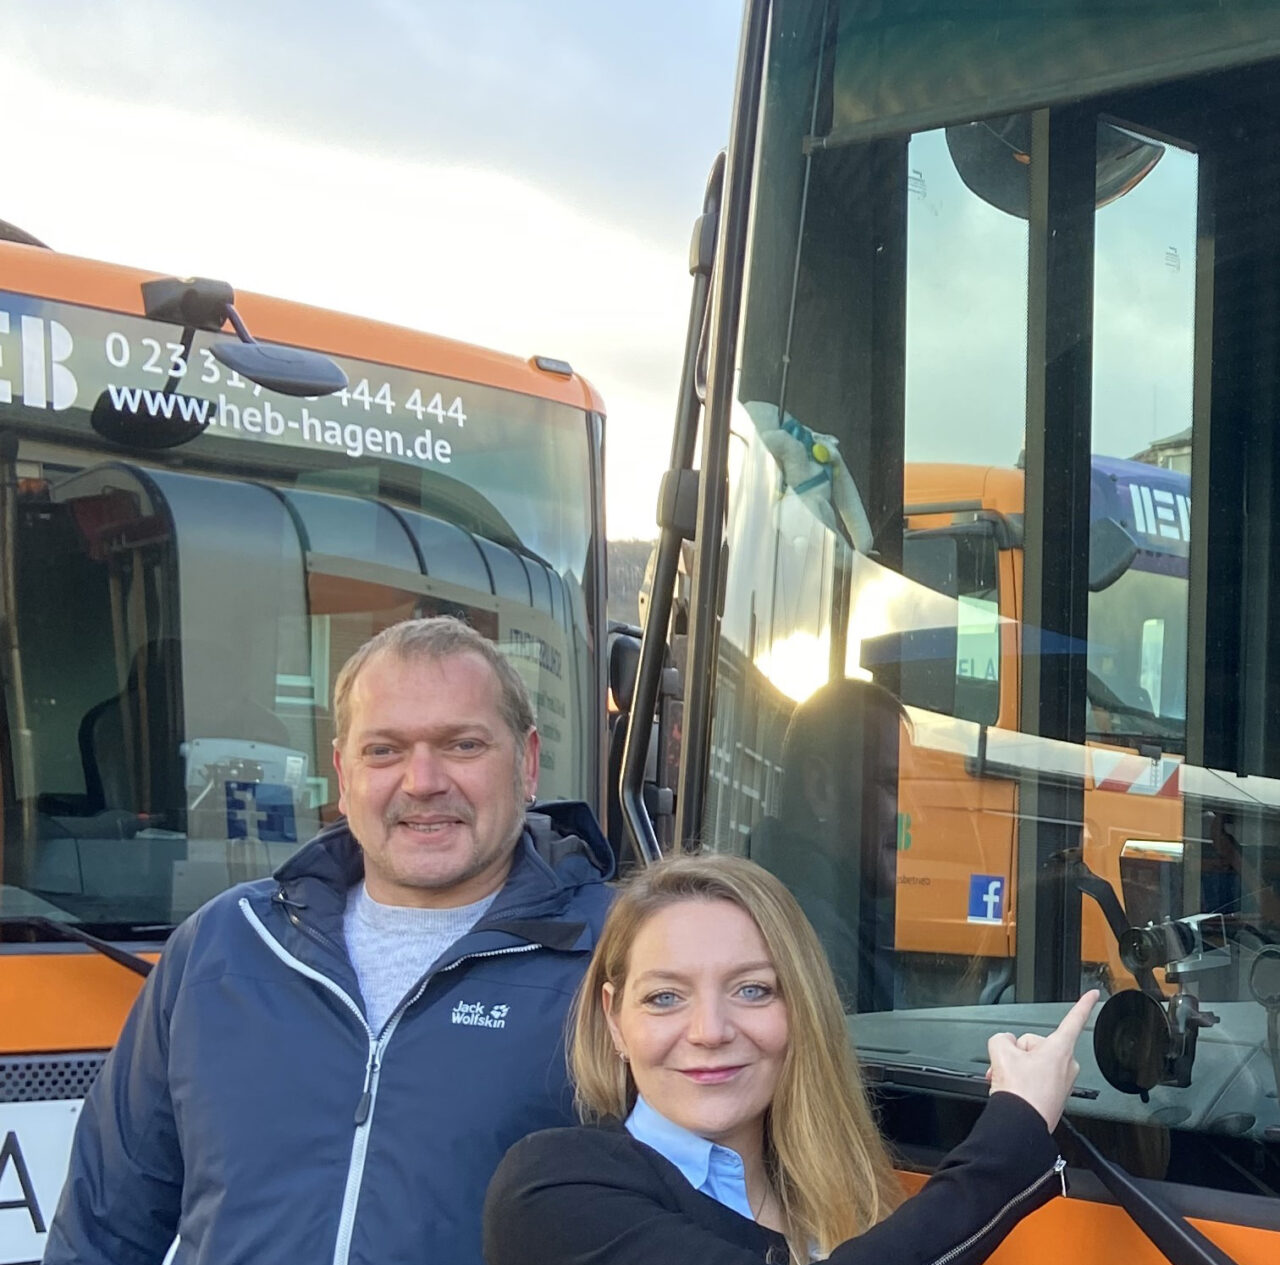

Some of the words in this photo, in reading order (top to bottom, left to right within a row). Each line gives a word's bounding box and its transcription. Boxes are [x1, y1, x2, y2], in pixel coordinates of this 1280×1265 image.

[0, 310, 78, 411] B
[105, 331, 130, 368] 0
[405, 388, 468, 428] 444
[107, 383, 452, 464] www.heb-hagen.de
[451, 1011, 506, 1029] Wolfskin
[452, 1000, 485, 1014] Jack
[0, 1131, 47, 1233] A
